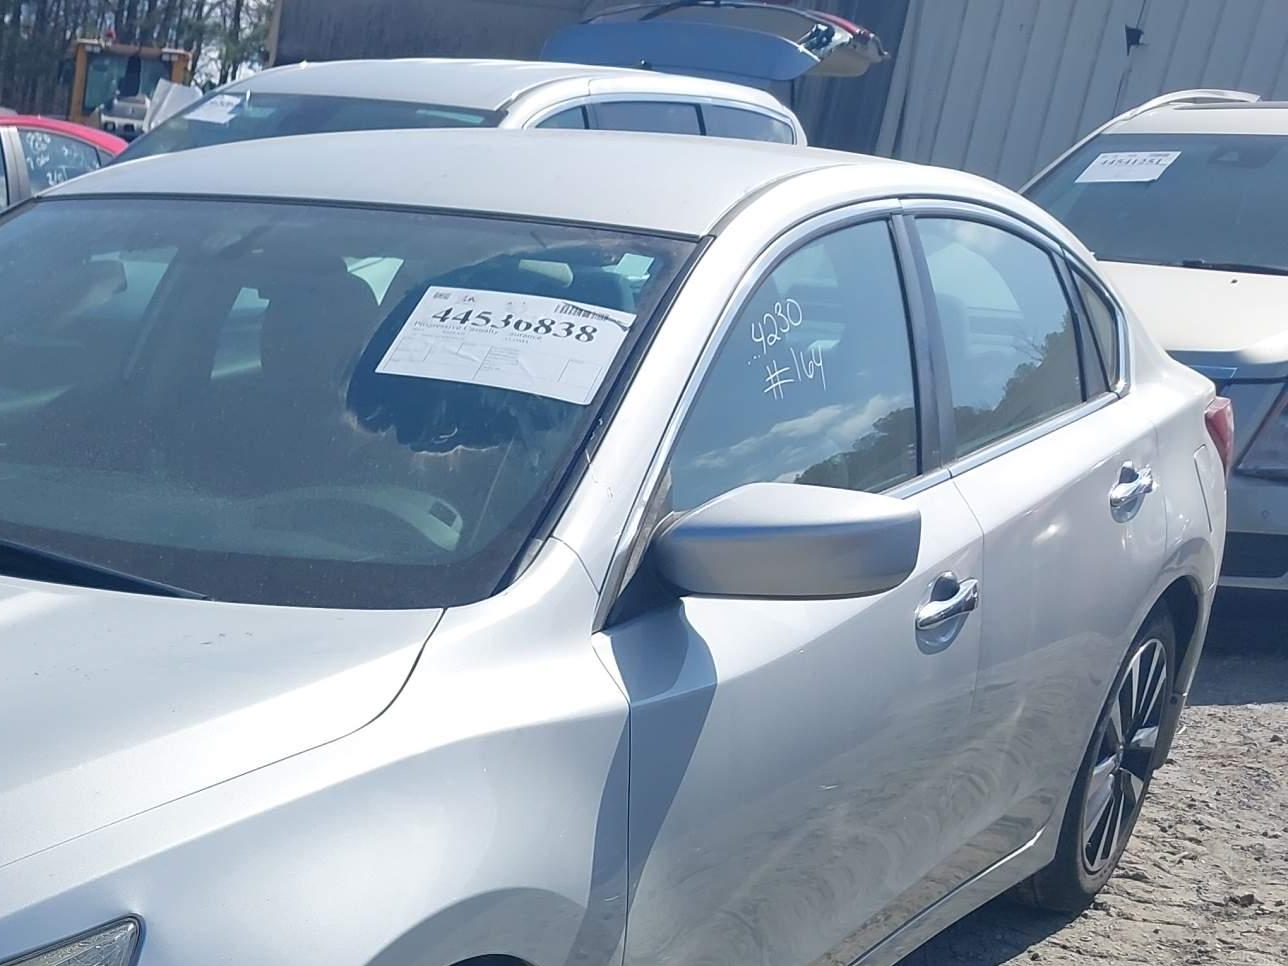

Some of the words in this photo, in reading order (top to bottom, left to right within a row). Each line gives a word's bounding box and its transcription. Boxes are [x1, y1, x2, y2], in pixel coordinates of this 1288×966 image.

[432, 306, 597, 343] 44536838
[751, 298, 803, 355] 4230
[763, 344, 827, 401] #164
